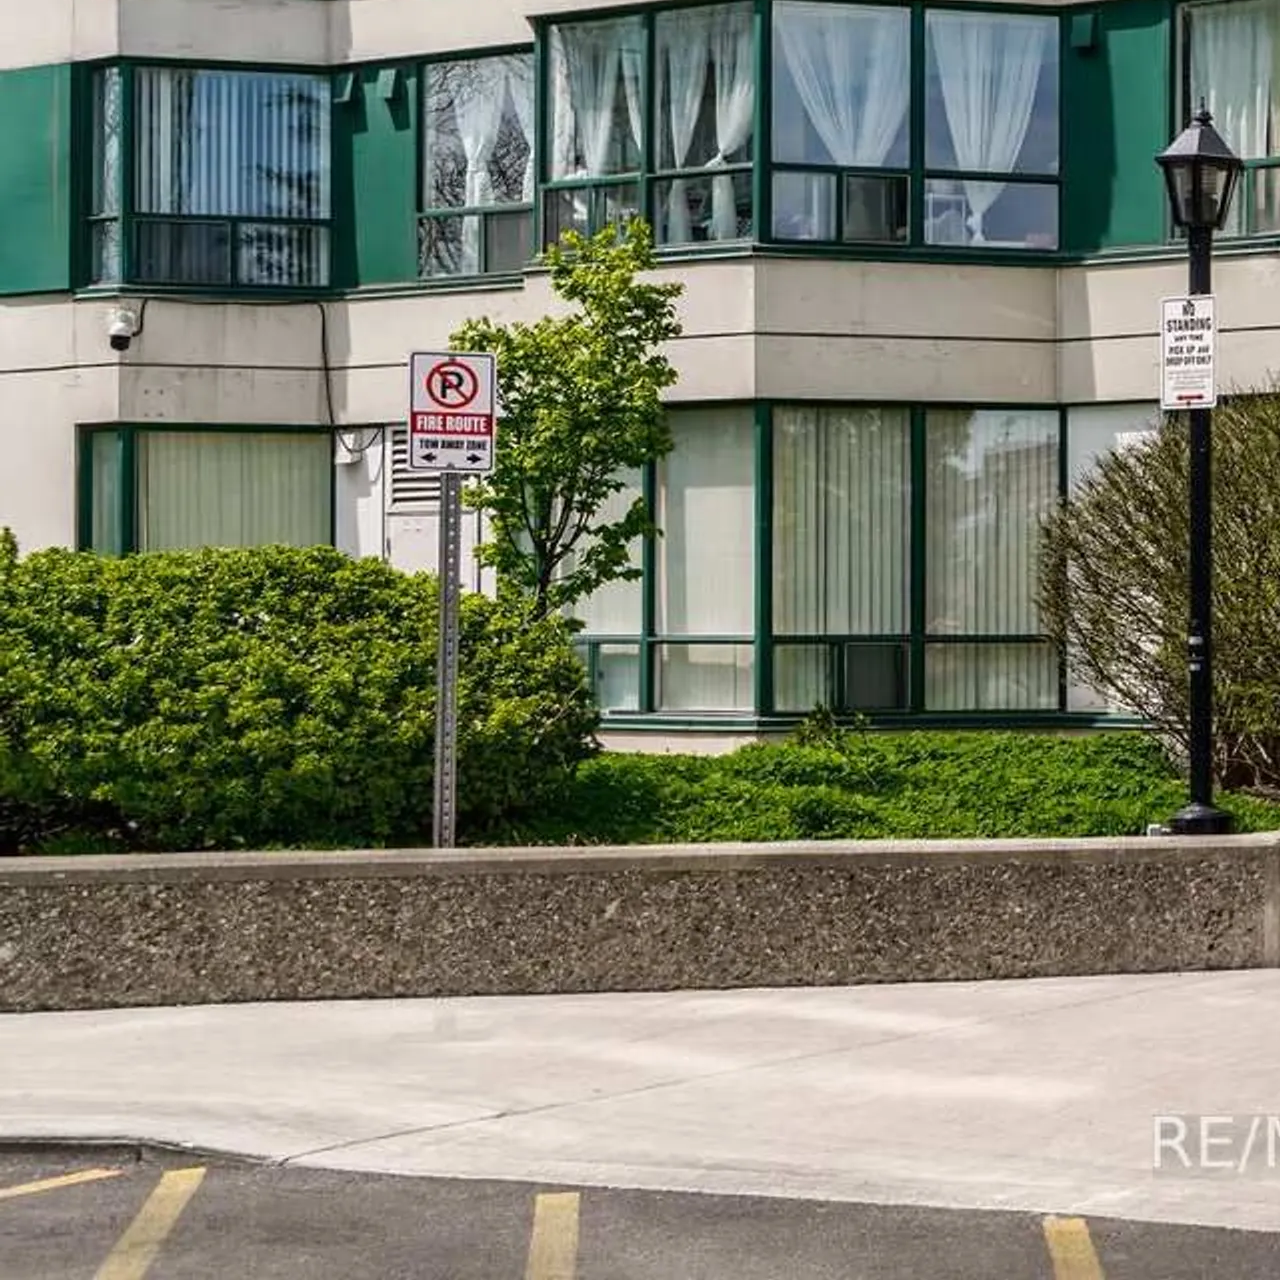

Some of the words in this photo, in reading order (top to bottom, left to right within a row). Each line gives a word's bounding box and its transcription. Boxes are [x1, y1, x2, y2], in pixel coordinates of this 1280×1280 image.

[1182, 304, 1195, 317] NO
[1166, 318, 1212, 333] STANDING
[1188, 333, 1204, 341] TIME
[1168, 346, 1184, 355] PICK
[1186, 345, 1196, 354] UP
[1166, 357, 1183, 367] DROP
[1184, 356, 1195, 366] OFF
[1196, 354, 1212, 365] ONLY
[416, 415, 444, 431] FIRE
[446, 416, 488, 432] ROUTE
[419, 439, 439, 450] TOW
[440, 439, 464, 450] AWAY
[466, 439, 488, 451] ZONE
